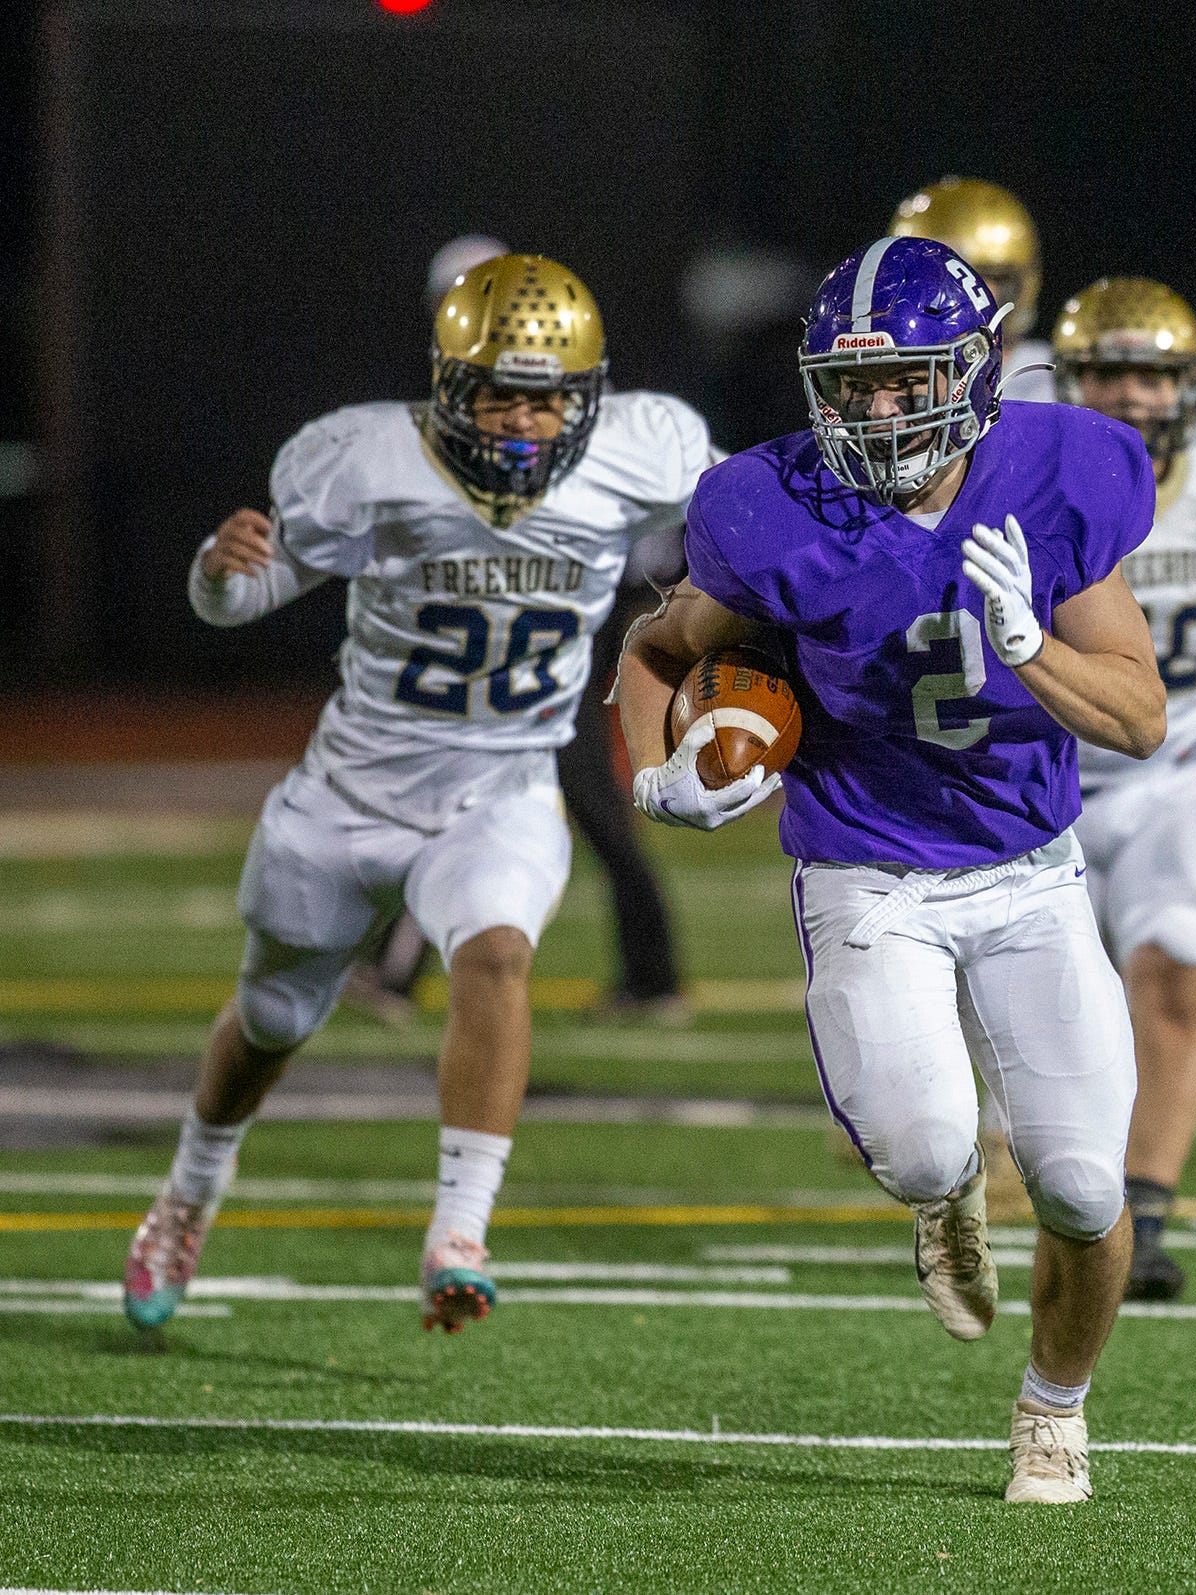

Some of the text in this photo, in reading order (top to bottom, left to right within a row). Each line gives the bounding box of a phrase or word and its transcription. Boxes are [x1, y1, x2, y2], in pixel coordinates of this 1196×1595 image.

[945, 258, 991, 312] 2
[837, 336, 885, 349] Riddell
[421, 556, 584, 594] FREEHOLD
[905, 608, 993, 751] 2
